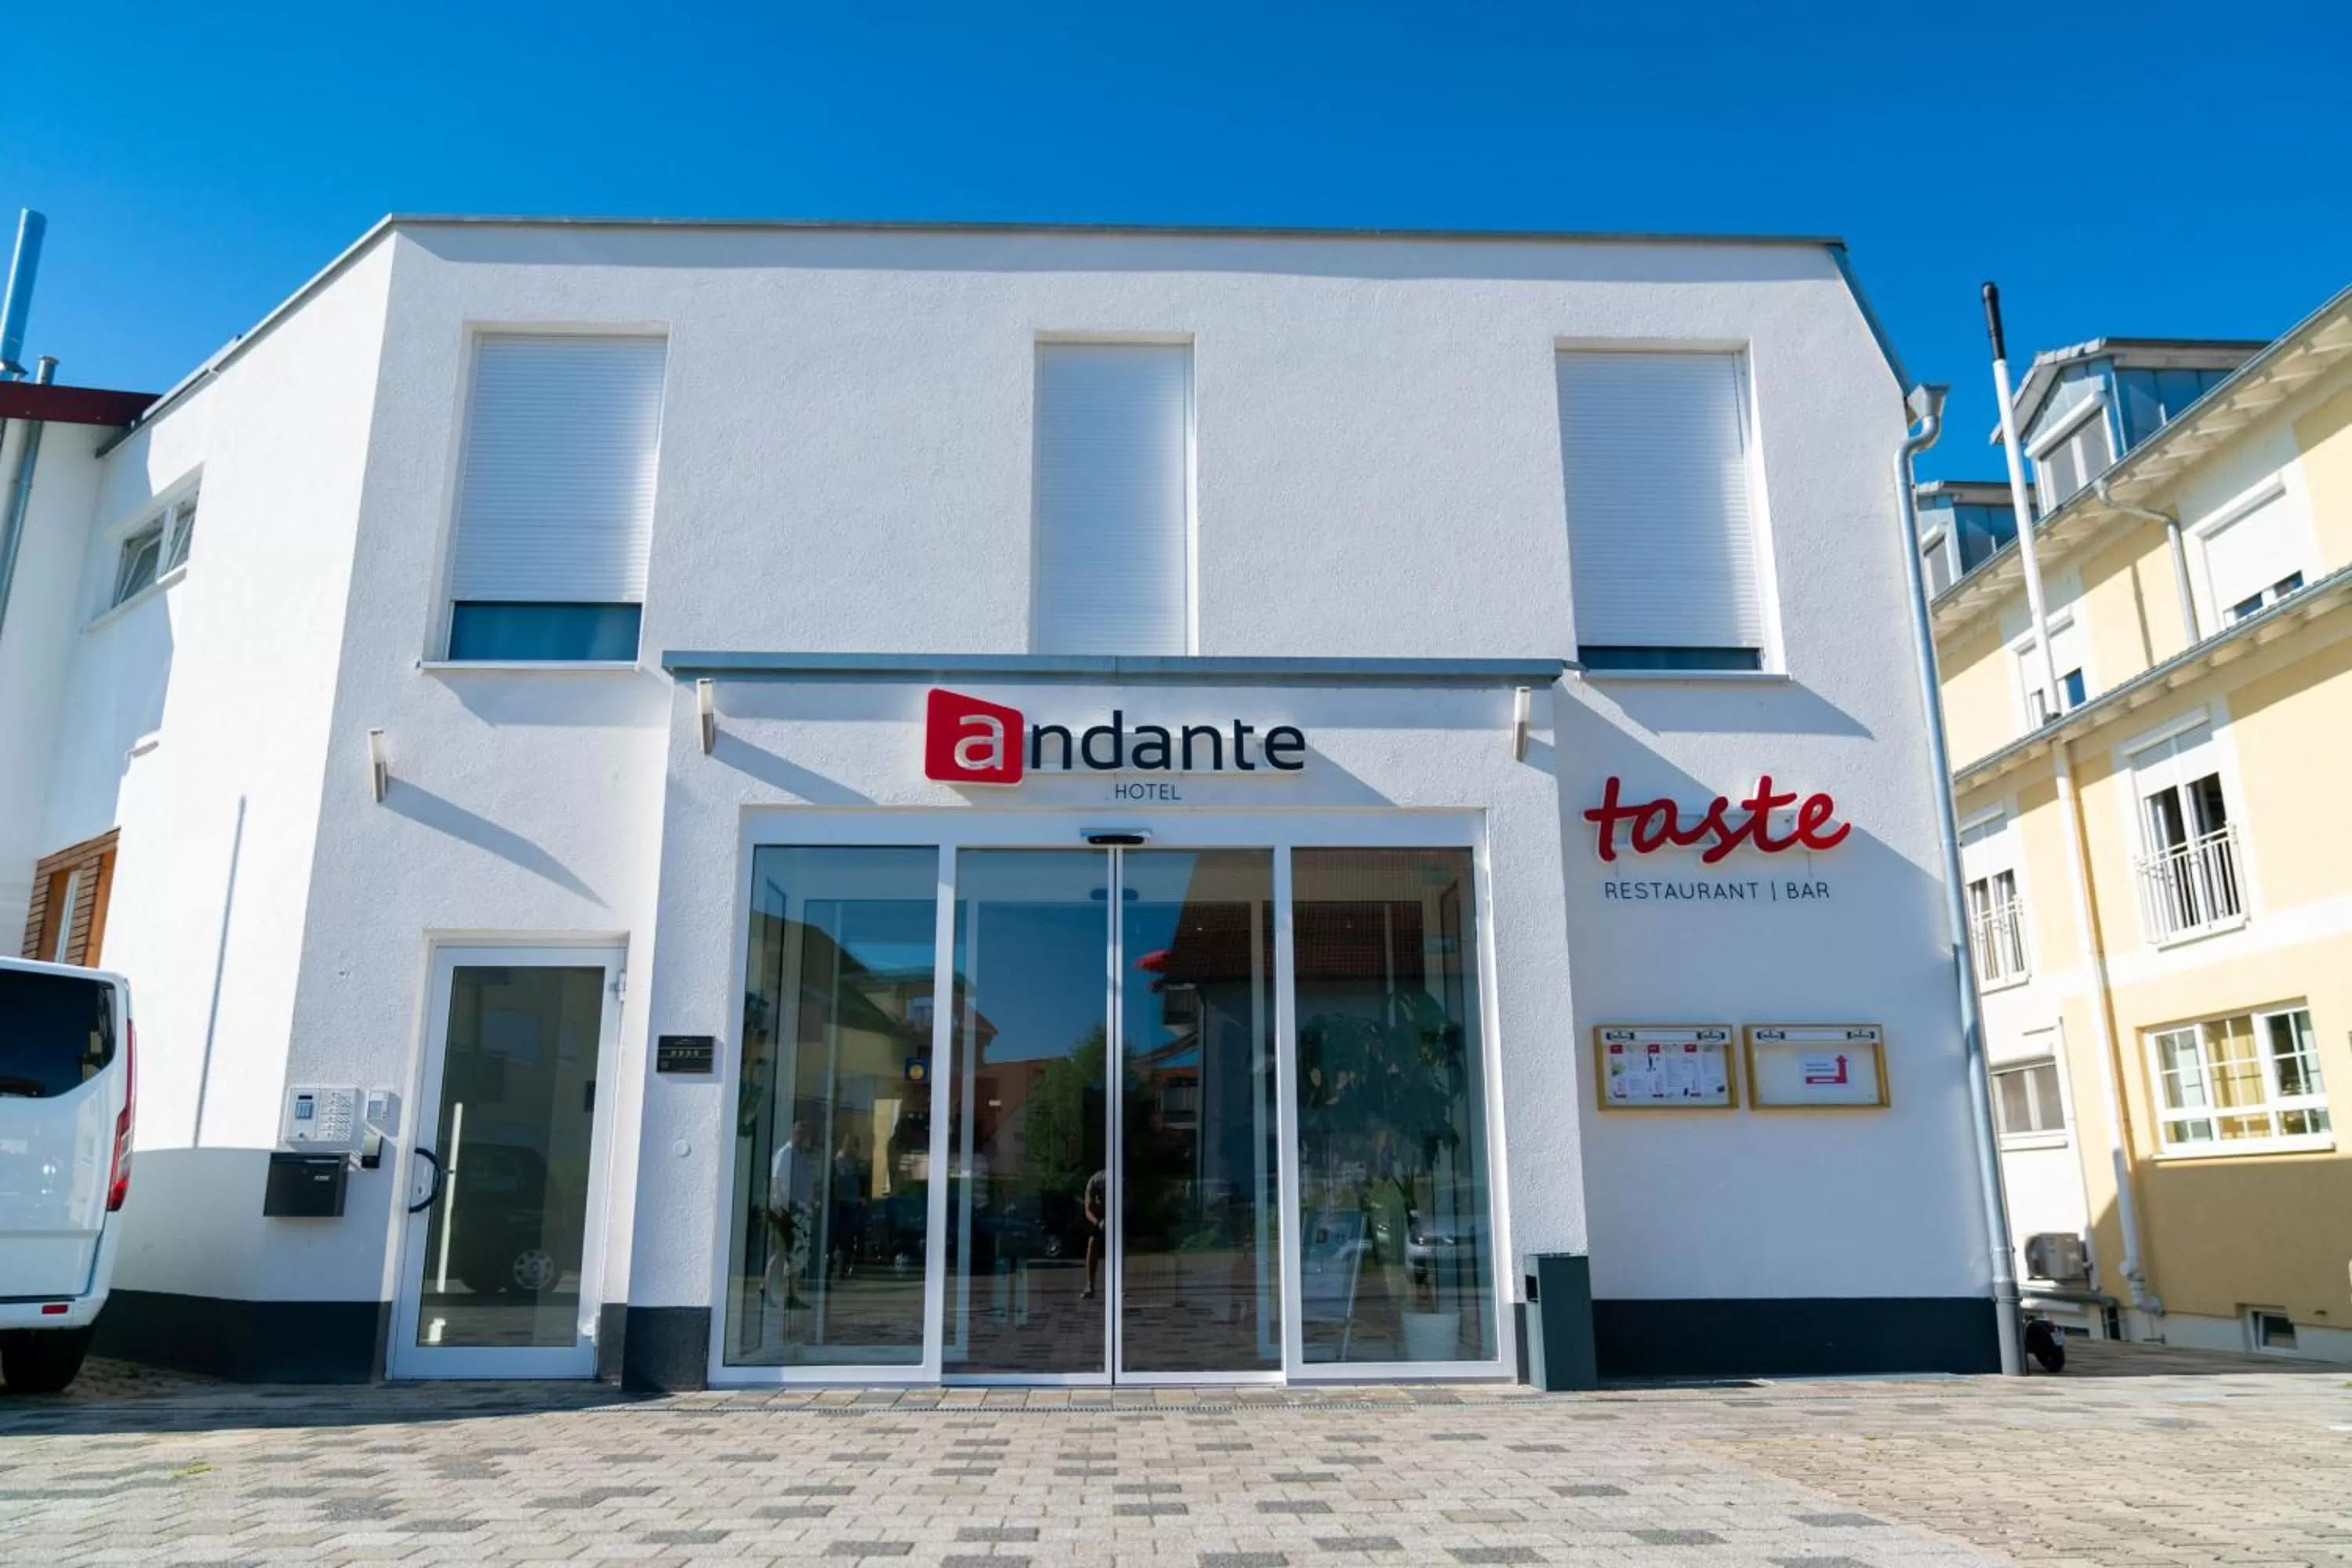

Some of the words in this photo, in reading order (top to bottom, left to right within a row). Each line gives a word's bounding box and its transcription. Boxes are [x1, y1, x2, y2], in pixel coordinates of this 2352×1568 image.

[953, 710, 1306, 771] andante
[1115, 782, 1182, 800] HOTEL
[1584, 775, 1851, 864] taste
[1605, 882, 1759, 900] RESTAURANT
[1786, 882, 1830, 899] BAR
